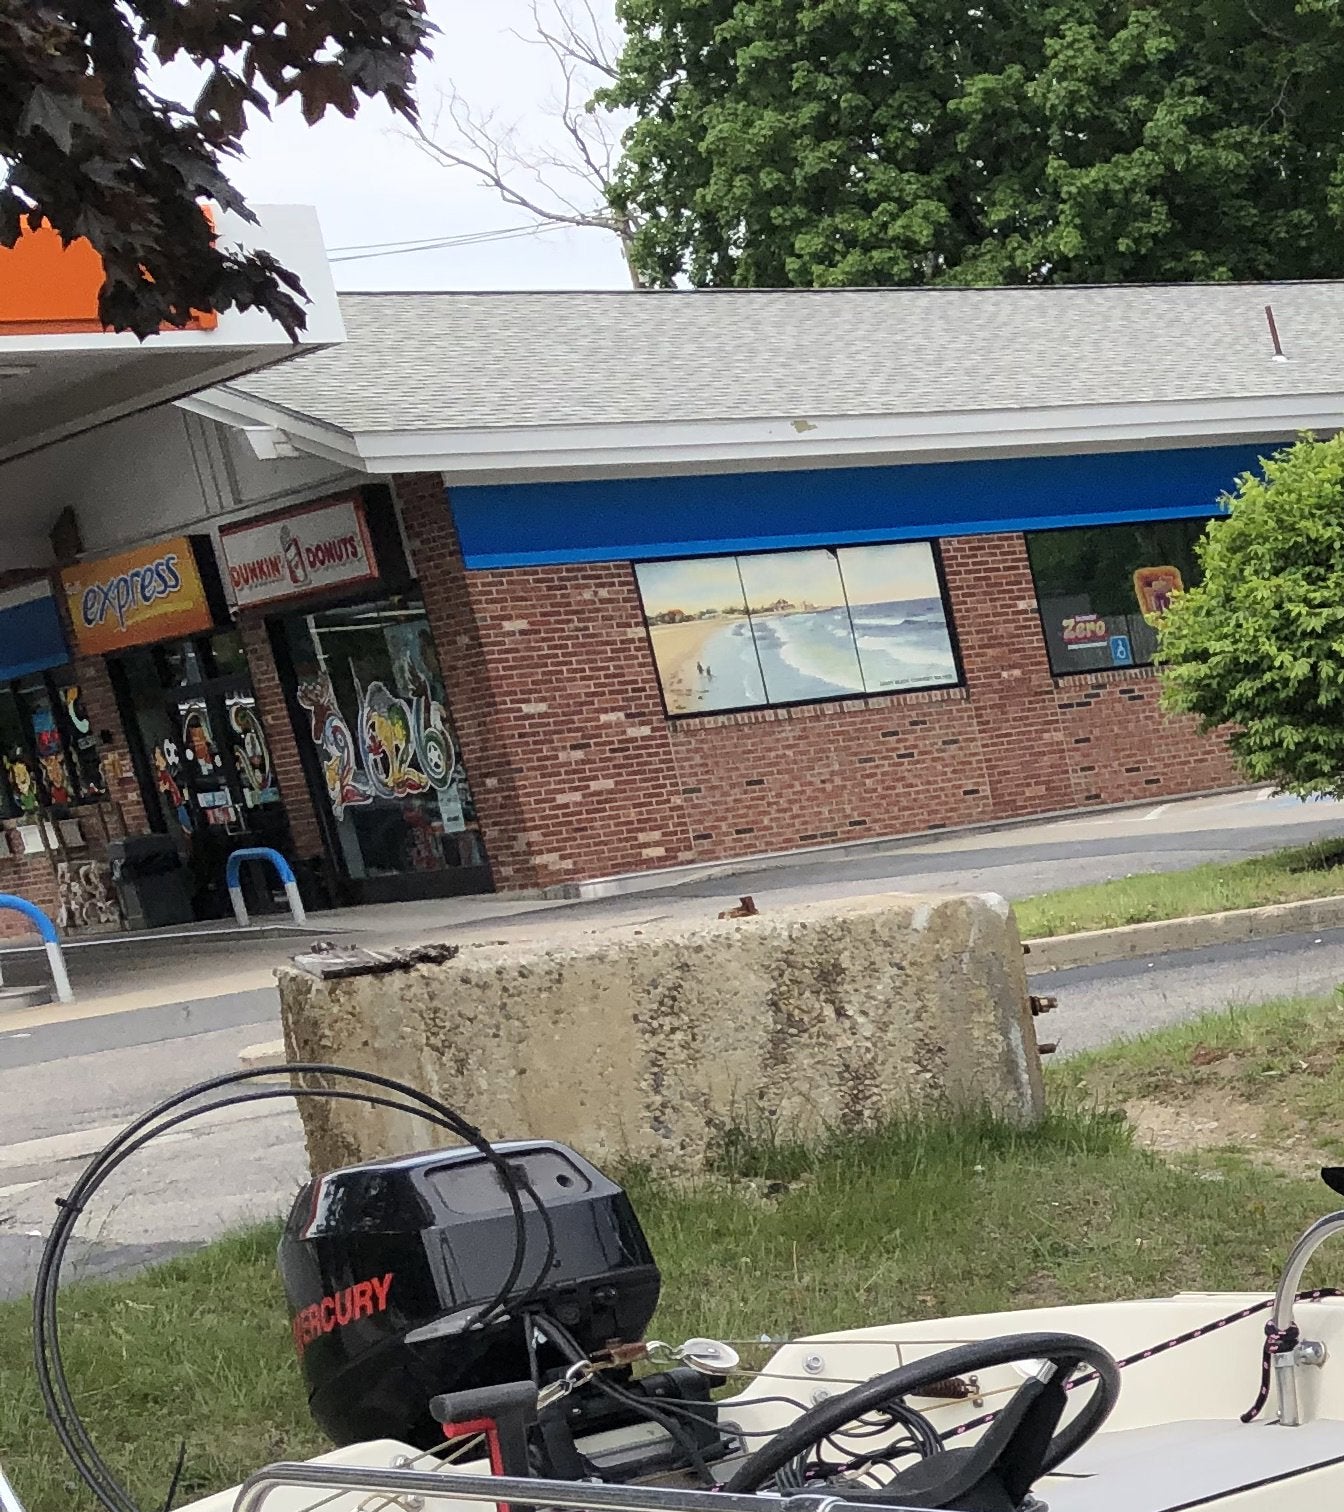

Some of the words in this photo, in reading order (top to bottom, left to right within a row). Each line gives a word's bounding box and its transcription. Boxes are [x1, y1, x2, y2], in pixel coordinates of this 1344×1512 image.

[230, 555, 282, 588] DUNKIN'
[305, 535, 359, 569] DONUTS
[81, 554, 182, 632] express
[1062, 619, 1106, 640] Zero
